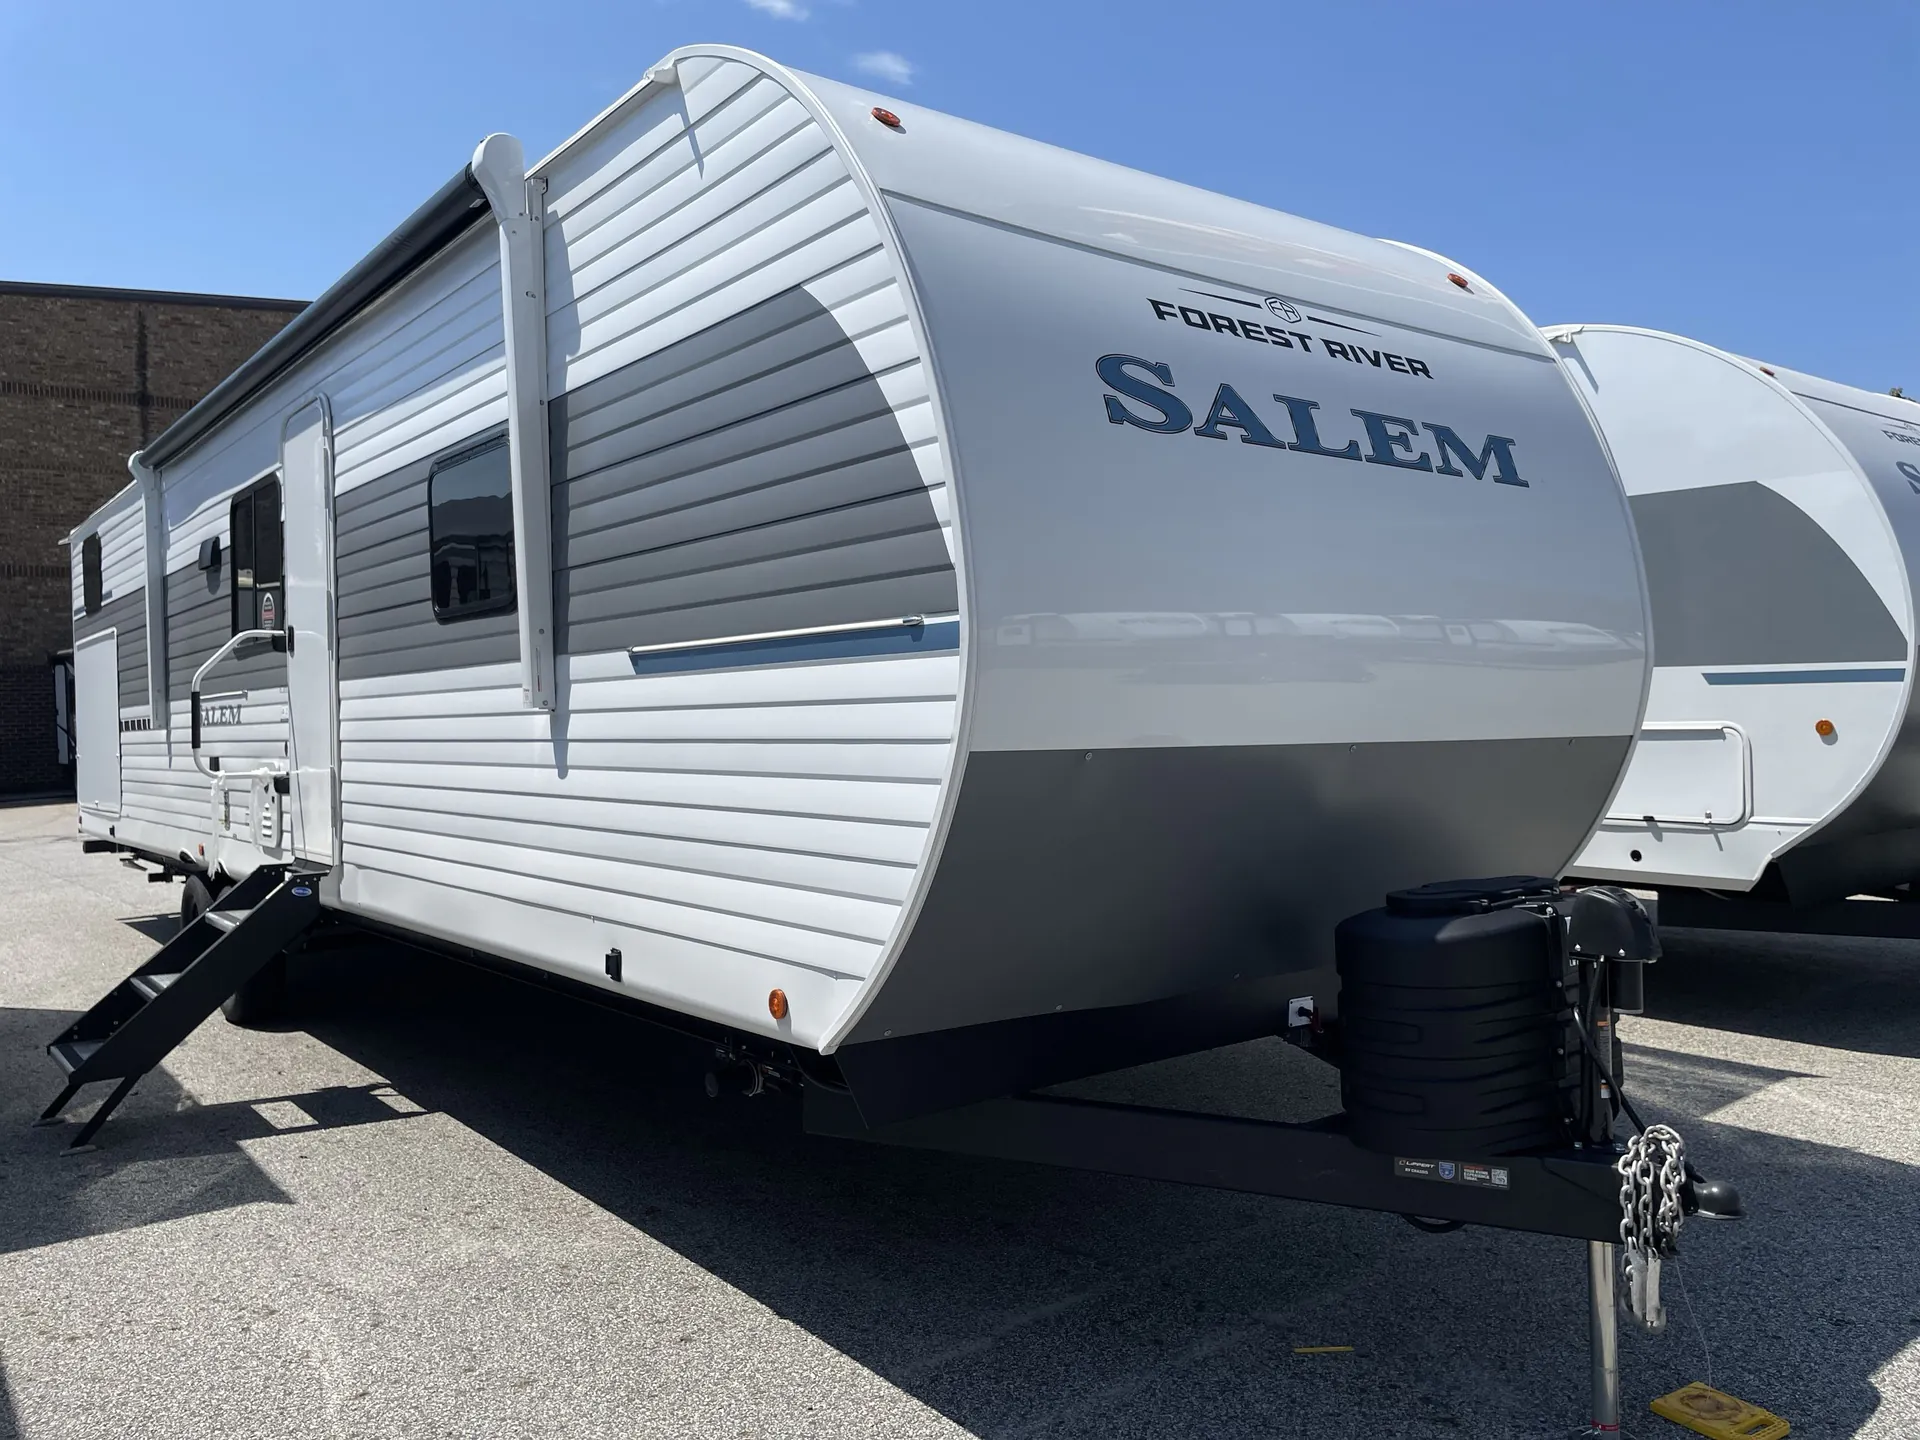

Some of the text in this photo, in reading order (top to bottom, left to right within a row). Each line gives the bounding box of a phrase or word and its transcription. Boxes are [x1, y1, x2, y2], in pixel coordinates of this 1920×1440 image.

[1146, 297, 1434, 379] FOREST RIVER
[1095, 353, 1530, 488] SALEM
[1880, 429, 1920, 446] FORE
[200, 703, 243, 727] ALEM
